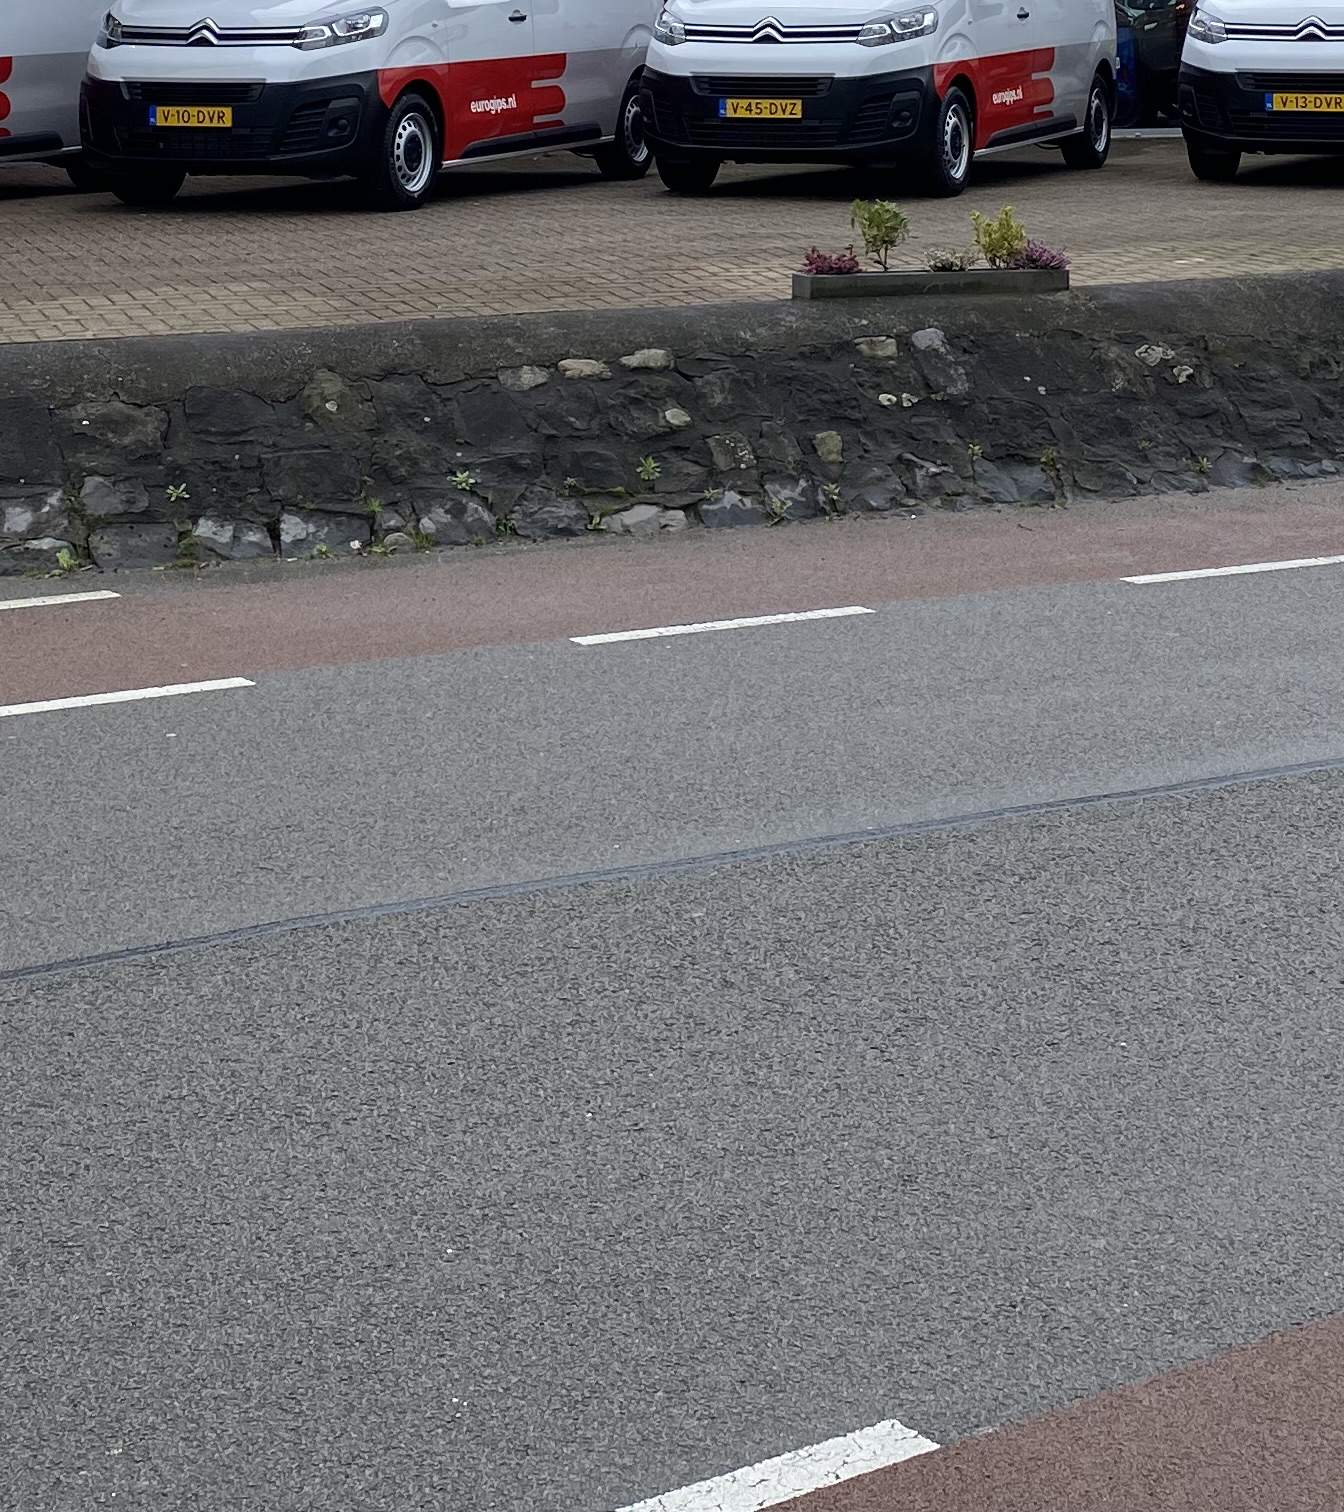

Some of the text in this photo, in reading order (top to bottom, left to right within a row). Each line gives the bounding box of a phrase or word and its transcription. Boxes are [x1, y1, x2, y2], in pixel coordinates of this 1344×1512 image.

[470, 93, 517, 114] eurogips.nl
[730, 101, 798, 116] V-45-DVZ
[1280, 95, 1344, 110] V-13-DVR
[161, 109, 226, 125] V-10-DVR
